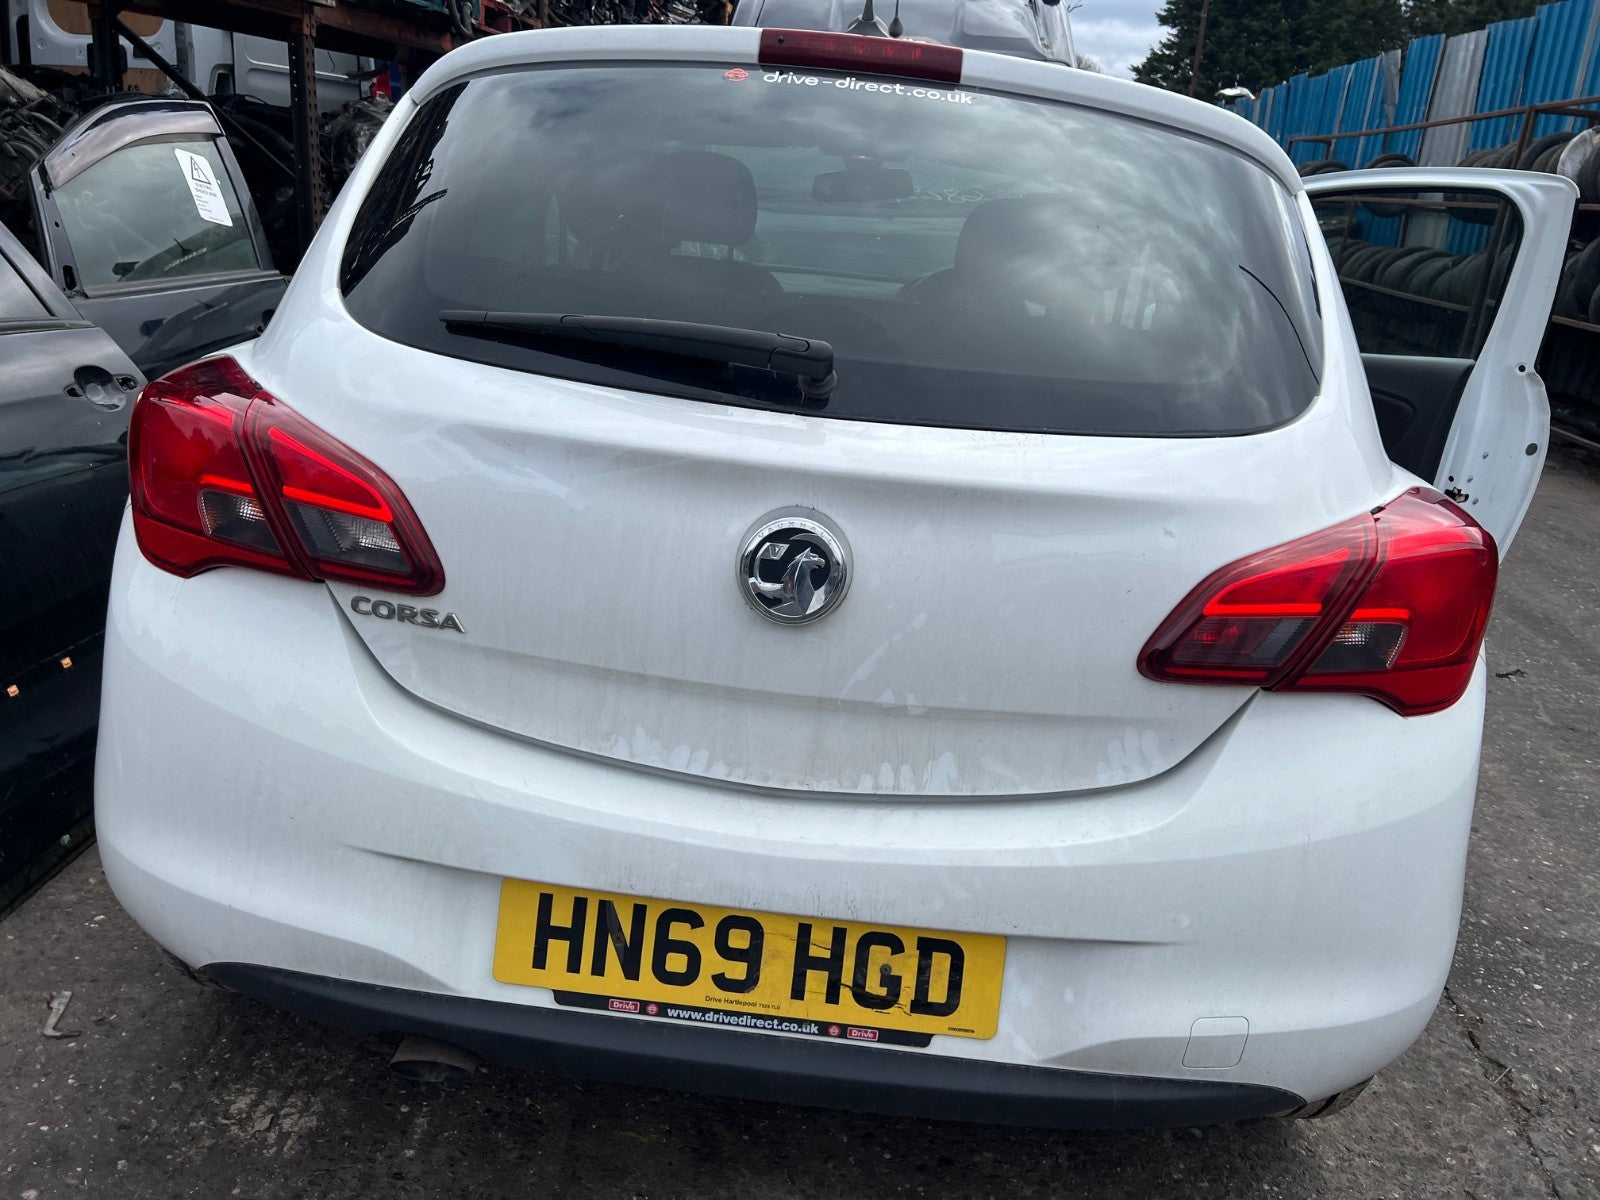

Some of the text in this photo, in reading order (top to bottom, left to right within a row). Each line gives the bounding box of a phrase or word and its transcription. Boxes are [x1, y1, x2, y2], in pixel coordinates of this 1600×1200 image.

[763, 71, 973, 105] drive-direct.co.uk
[350, 595, 466, 633] CORSA
[531, 892, 966, 1017] HN69 HGD
[705, 995, 722, 1003] Drive
[723, 998, 757, 1007] Hartlepool
[613, 1001, 874, 1040] Drive www.drivedirect.co.uk Drive
